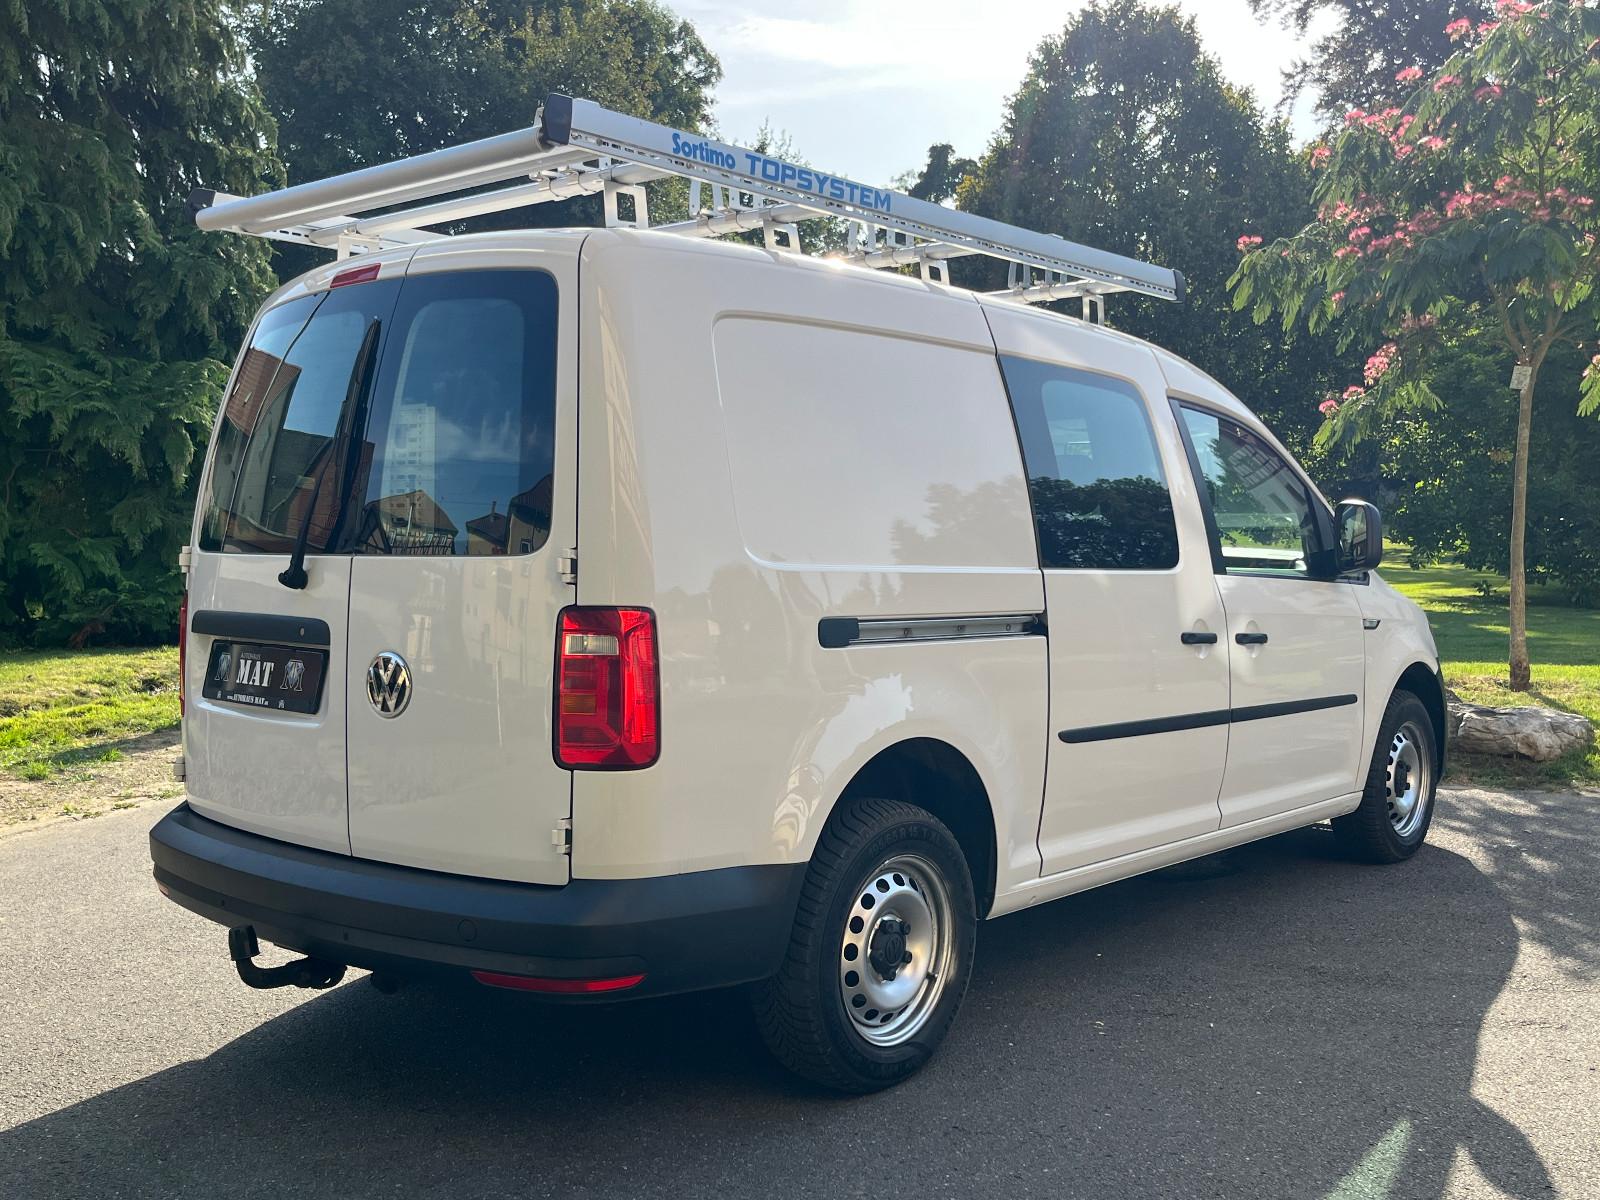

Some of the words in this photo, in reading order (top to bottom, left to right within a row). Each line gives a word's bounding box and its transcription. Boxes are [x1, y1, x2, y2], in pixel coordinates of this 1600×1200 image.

[671, 132, 737, 170] Sortimo
[745, 153, 892, 213] TOPSYSTEM
[236, 659, 275, 687] MAT
